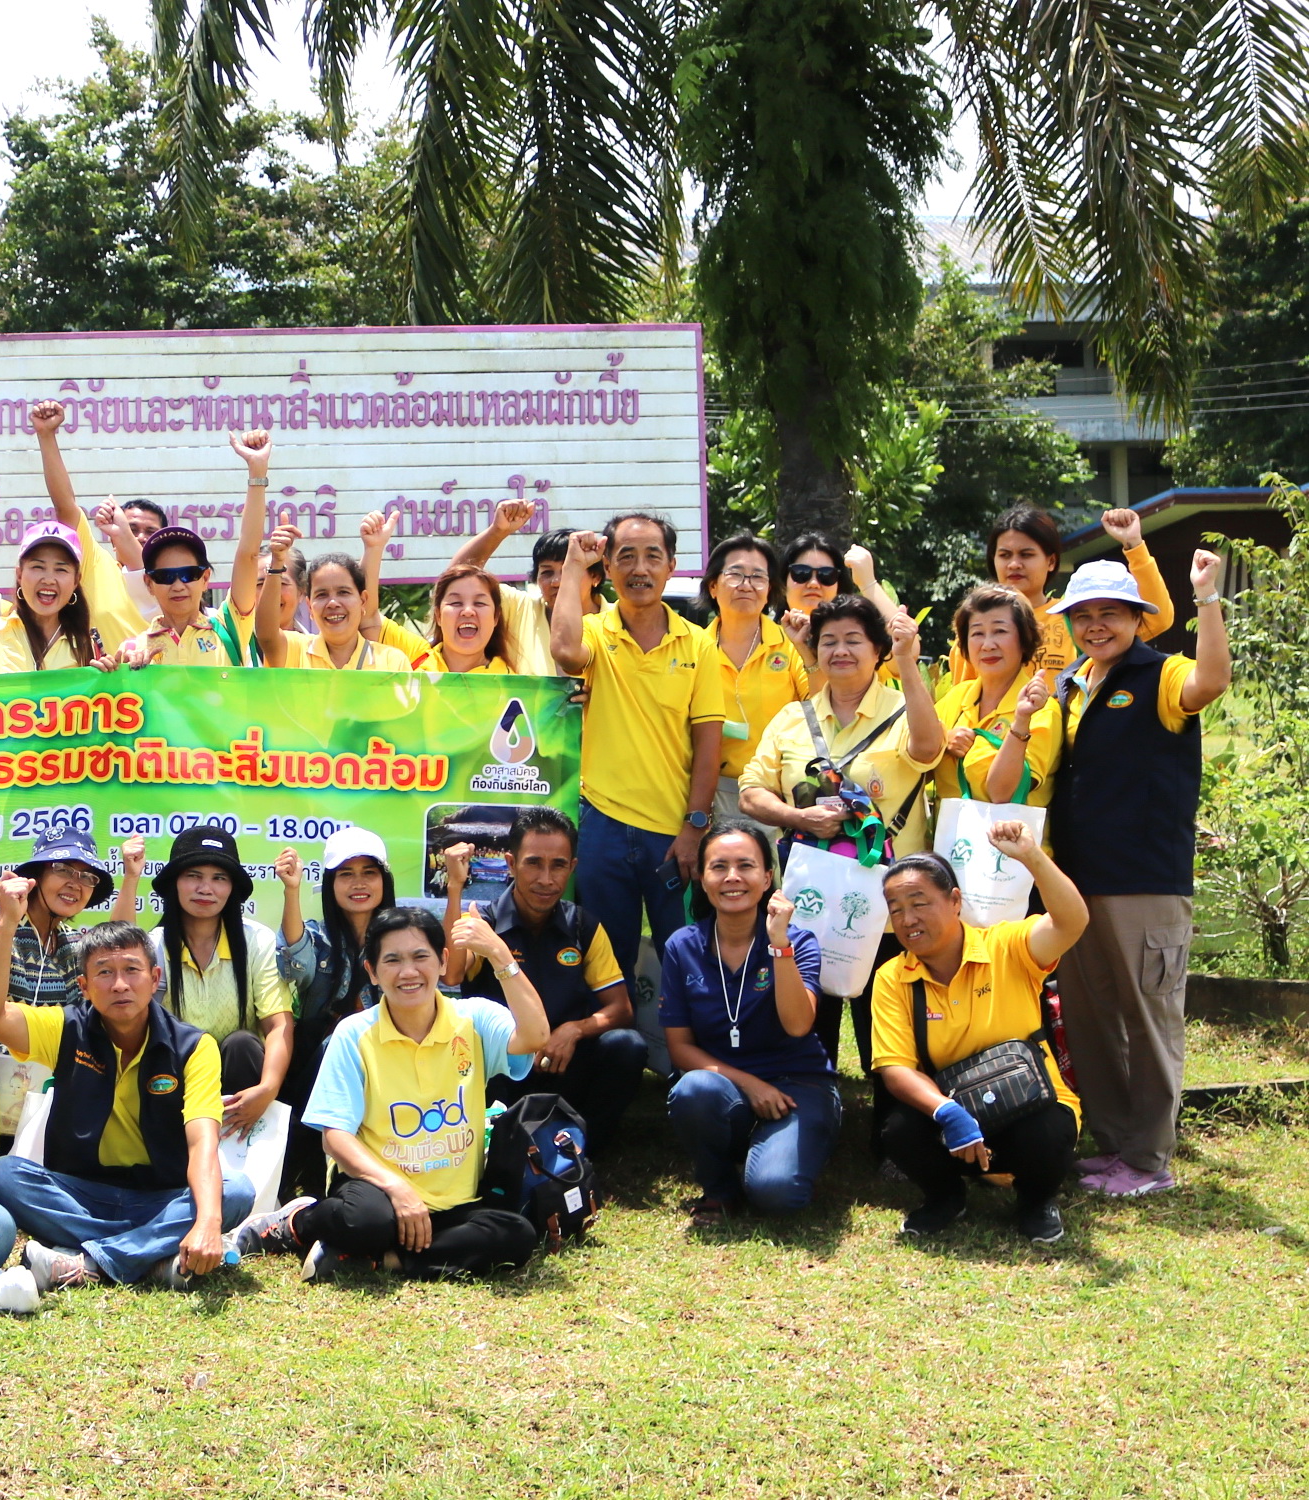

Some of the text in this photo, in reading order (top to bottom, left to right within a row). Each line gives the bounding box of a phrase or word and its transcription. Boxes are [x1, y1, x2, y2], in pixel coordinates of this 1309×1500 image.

[384, 474, 551, 559] ศูนย์ภาใต้
[484, 766, 538, 777] อาสาสมัคร
[472, 776, 548, 792] ท้องถิ่นรักษ์โลก
[112, 815, 161, 834] เวลา
[382, 1126, 474, 1162] ปั่นเพื่อพ่อ
[396, 1163, 420, 1173] IKE
[425, 1158, 450, 1172] FOR
